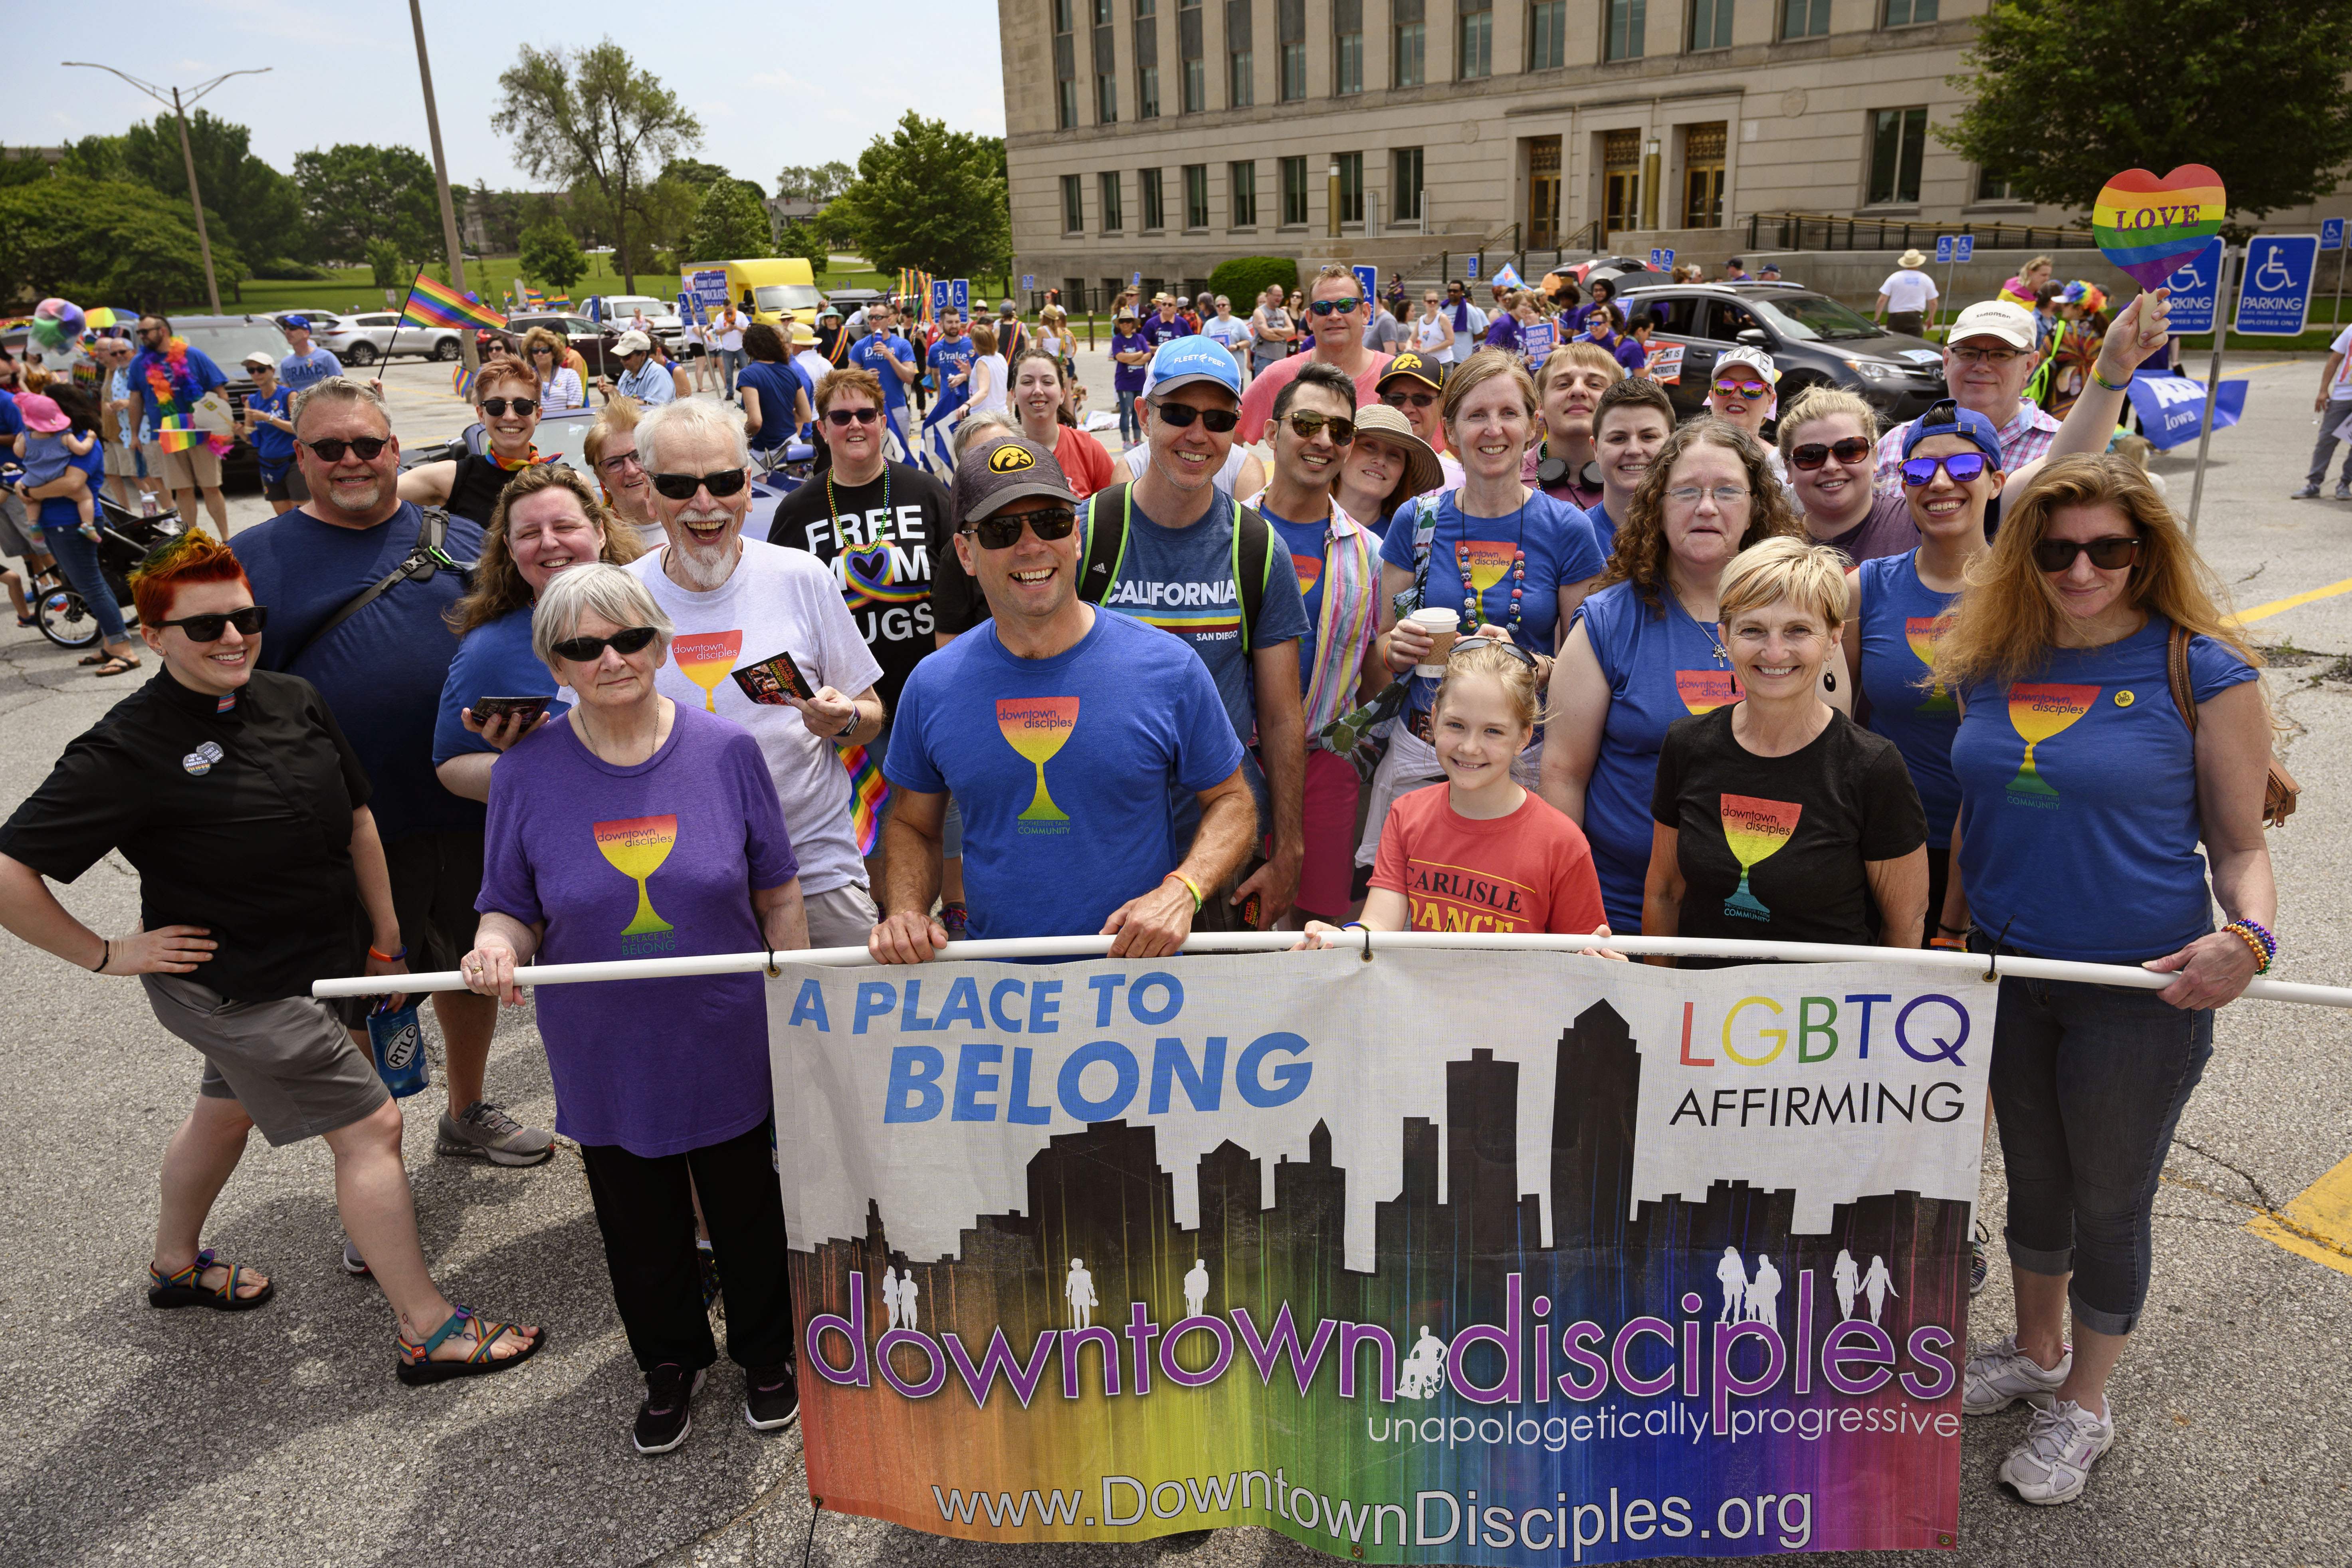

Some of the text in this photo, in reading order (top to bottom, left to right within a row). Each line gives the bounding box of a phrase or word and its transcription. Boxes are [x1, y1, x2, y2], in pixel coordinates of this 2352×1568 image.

[2114, 205, 2199, 232] LOVE
[697, 288, 728, 300] EMOCRATS
[2166, 297, 2211, 309] RKING
[2242, 297, 2302, 310] PARKING
[1527, 328, 1548, 338] TRANS
[1528, 336, 1550, 346] PEOPLE
[939, 350, 967, 361] Drake
[1174, 354, 1226, 367] FLEET FEET
[1650, 349, 1680, 360] DENT IS
[287, 363, 323, 378] DRAKE
[1651, 365, 1677, 375] PATRIOTIC
[2164, 410, 2197, 431] Iowa
[805, 505, 925, 555] FREE
[1475, 557, 1510, 567] disciples
[1107, 579, 1238, 606] CALIFORNIA
[853, 603, 934, 645] UGS
[1907, 624, 1948, 634] downto
[1196, 630, 1238, 642] SAN DIEGO
[674, 643, 723, 654] downtown
[697, 647, 737, 660] disciples
[780, 658, 795, 680] JOYFUL
[769, 662, 789, 690] WORSHIP
[1678, 678, 1730, 690] downtown
[2009, 691, 2070, 704] downtown
[2117, 695, 2131, 703] VOICE
[999, 708, 1056, 720] downtown
[2032, 702, 2084, 716] disciples
[1024, 716, 1072, 731] disciples
[204, 746, 215, 755] THEY
[207, 749, 220, 759] THEM
[211, 753, 224, 763] THEIR
[187, 763, 211, 773] QUEER
[2006, 790, 2043, 800] PROGRESSIVE
[2007, 796, 2060, 810] COMMUNITY
[1722, 804, 1777, 823] downtown
[597, 828, 655, 842] downtown
[1746, 821, 1790, 836] disciples
[625, 834, 672, 847] disciples
[1407, 866, 1522, 913] CARLISLE
[1724, 908, 1770, 923] COMMUNITY
[1758, 910, 1770, 918] FAITH
[631, 933, 659, 943] PLACE
[662, 931, 674, 939] TO
[622, 940, 676, 955] BELONG
[789, 972, 1184, 1035] A PLACE TO
[1680, 993, 1971, 1067] LGBTQ
[389, 1027, 416, 1065] RTLC
[883, 1032, 1313, 1125] BELONG
[1669, 1081, 1965, 1127] AFFIRMING
[806, 1269, 1957, 1436] downtown disciples
[1368, 1402, 1960, 1453] unapologetically progressive
[932, 1466, 1812, 1563] www.DowntownDisciples.org
